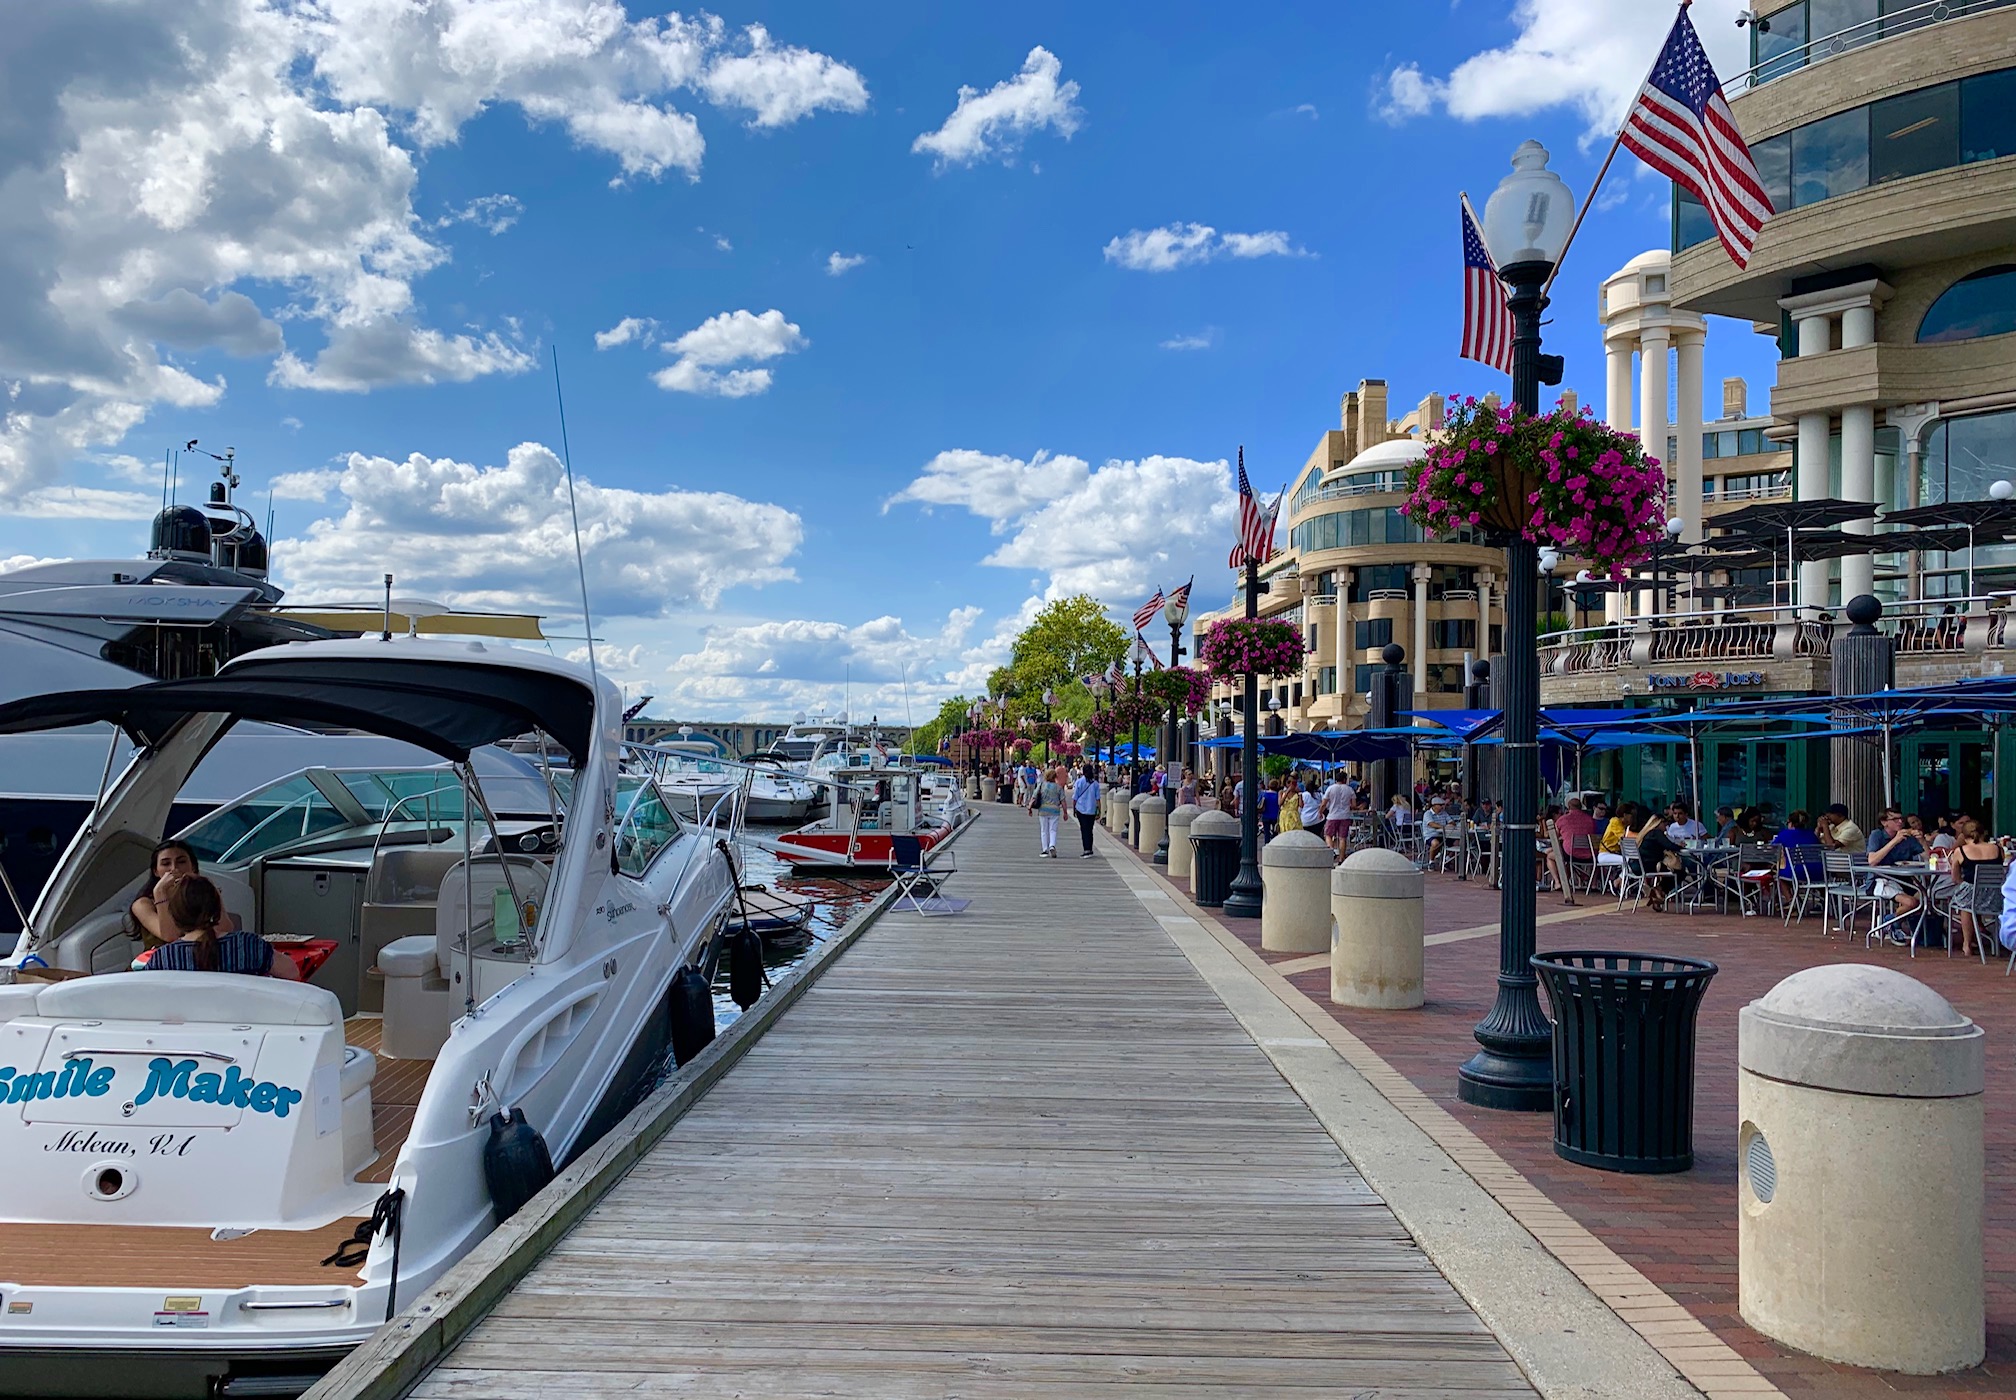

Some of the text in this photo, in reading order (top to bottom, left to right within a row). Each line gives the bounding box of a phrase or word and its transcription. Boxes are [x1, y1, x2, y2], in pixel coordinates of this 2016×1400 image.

[128, 596, 215, 607] MOKSHA
[1648, 673, 1688, 687] TONY
[1721, 671, 1761, 689] JOE'S
[134, 1057, 302, 1118] Maker
[43, 1129, 196, 1158] Mclean, VA
